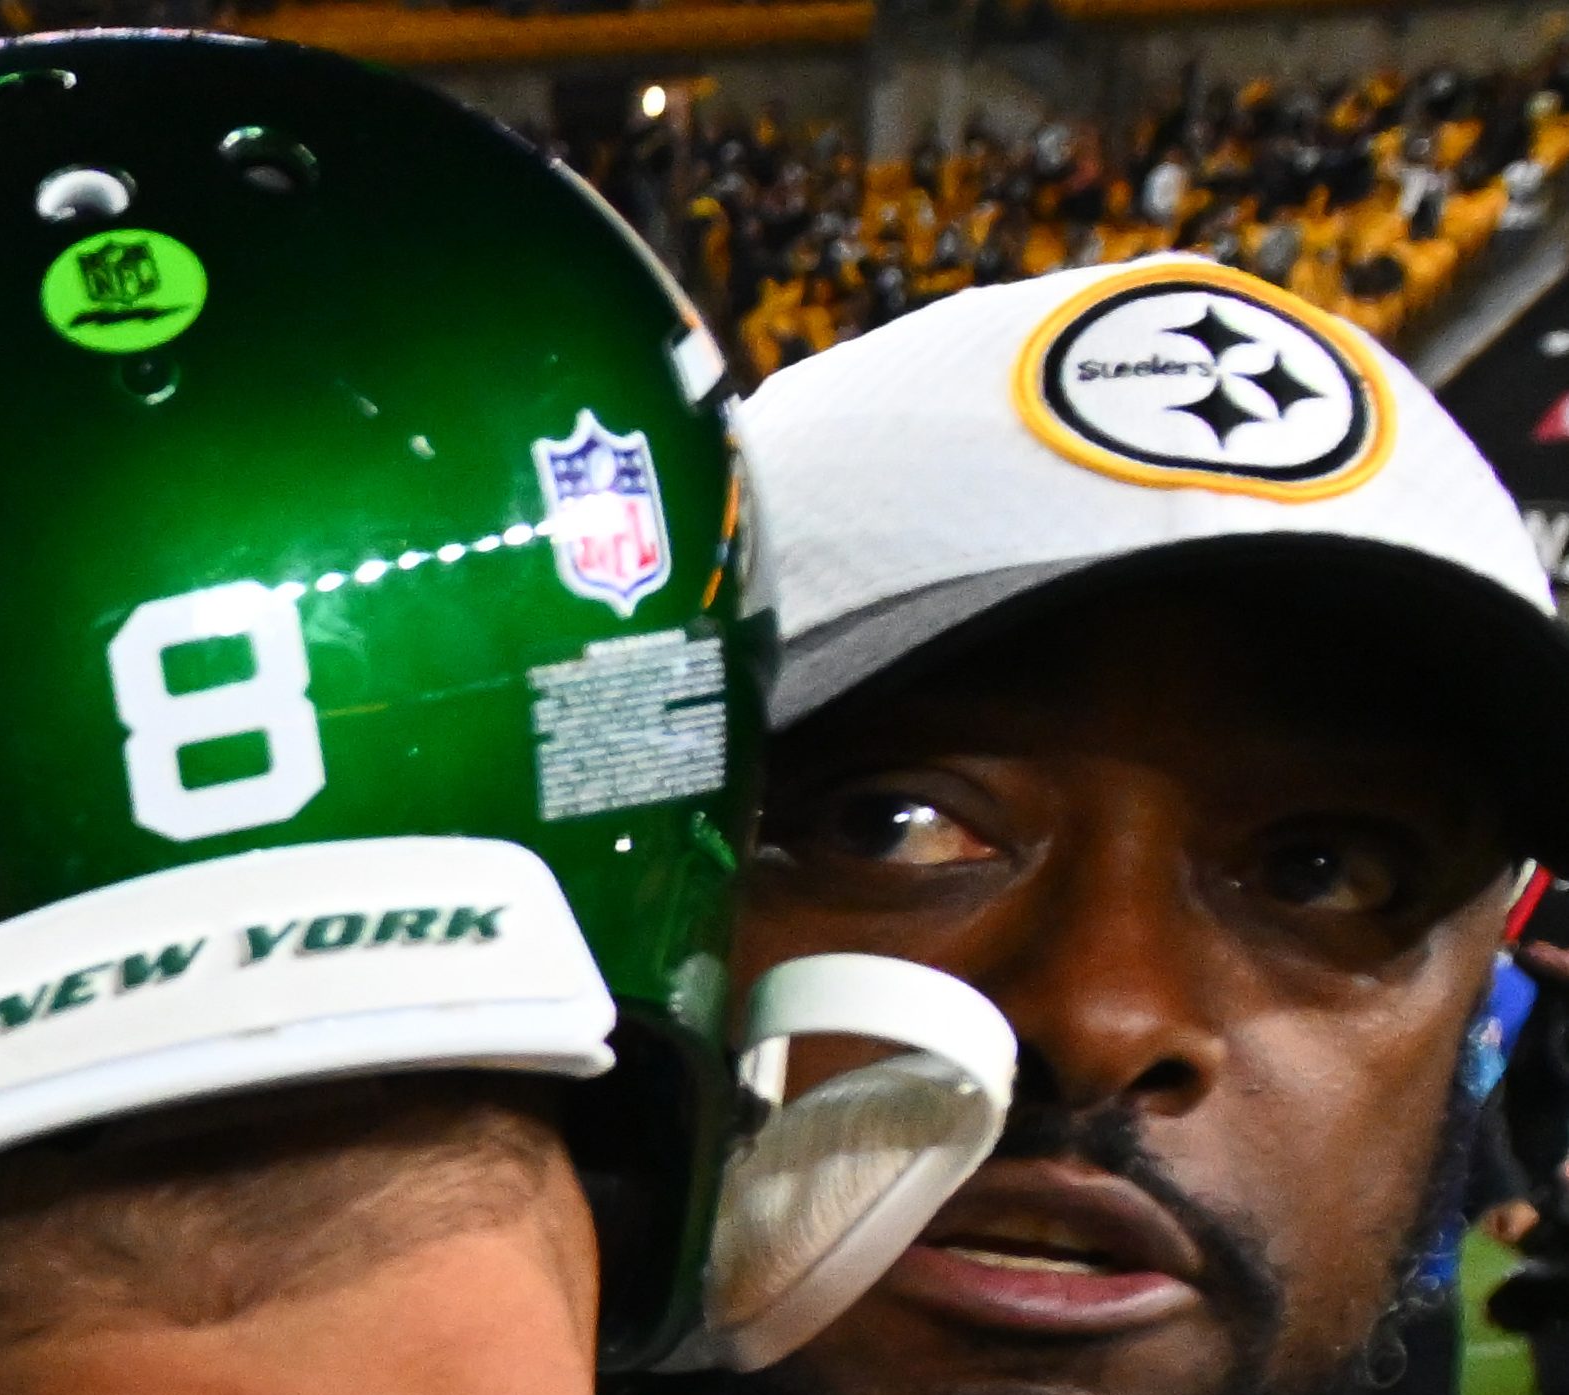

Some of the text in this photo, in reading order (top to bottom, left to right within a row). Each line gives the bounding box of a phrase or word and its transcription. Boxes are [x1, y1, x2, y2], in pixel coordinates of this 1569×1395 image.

[1077, 353, 1213, 382] Steelers
[110, 581, 326, 843] 8
[238, 903, 513, 968] YORK
